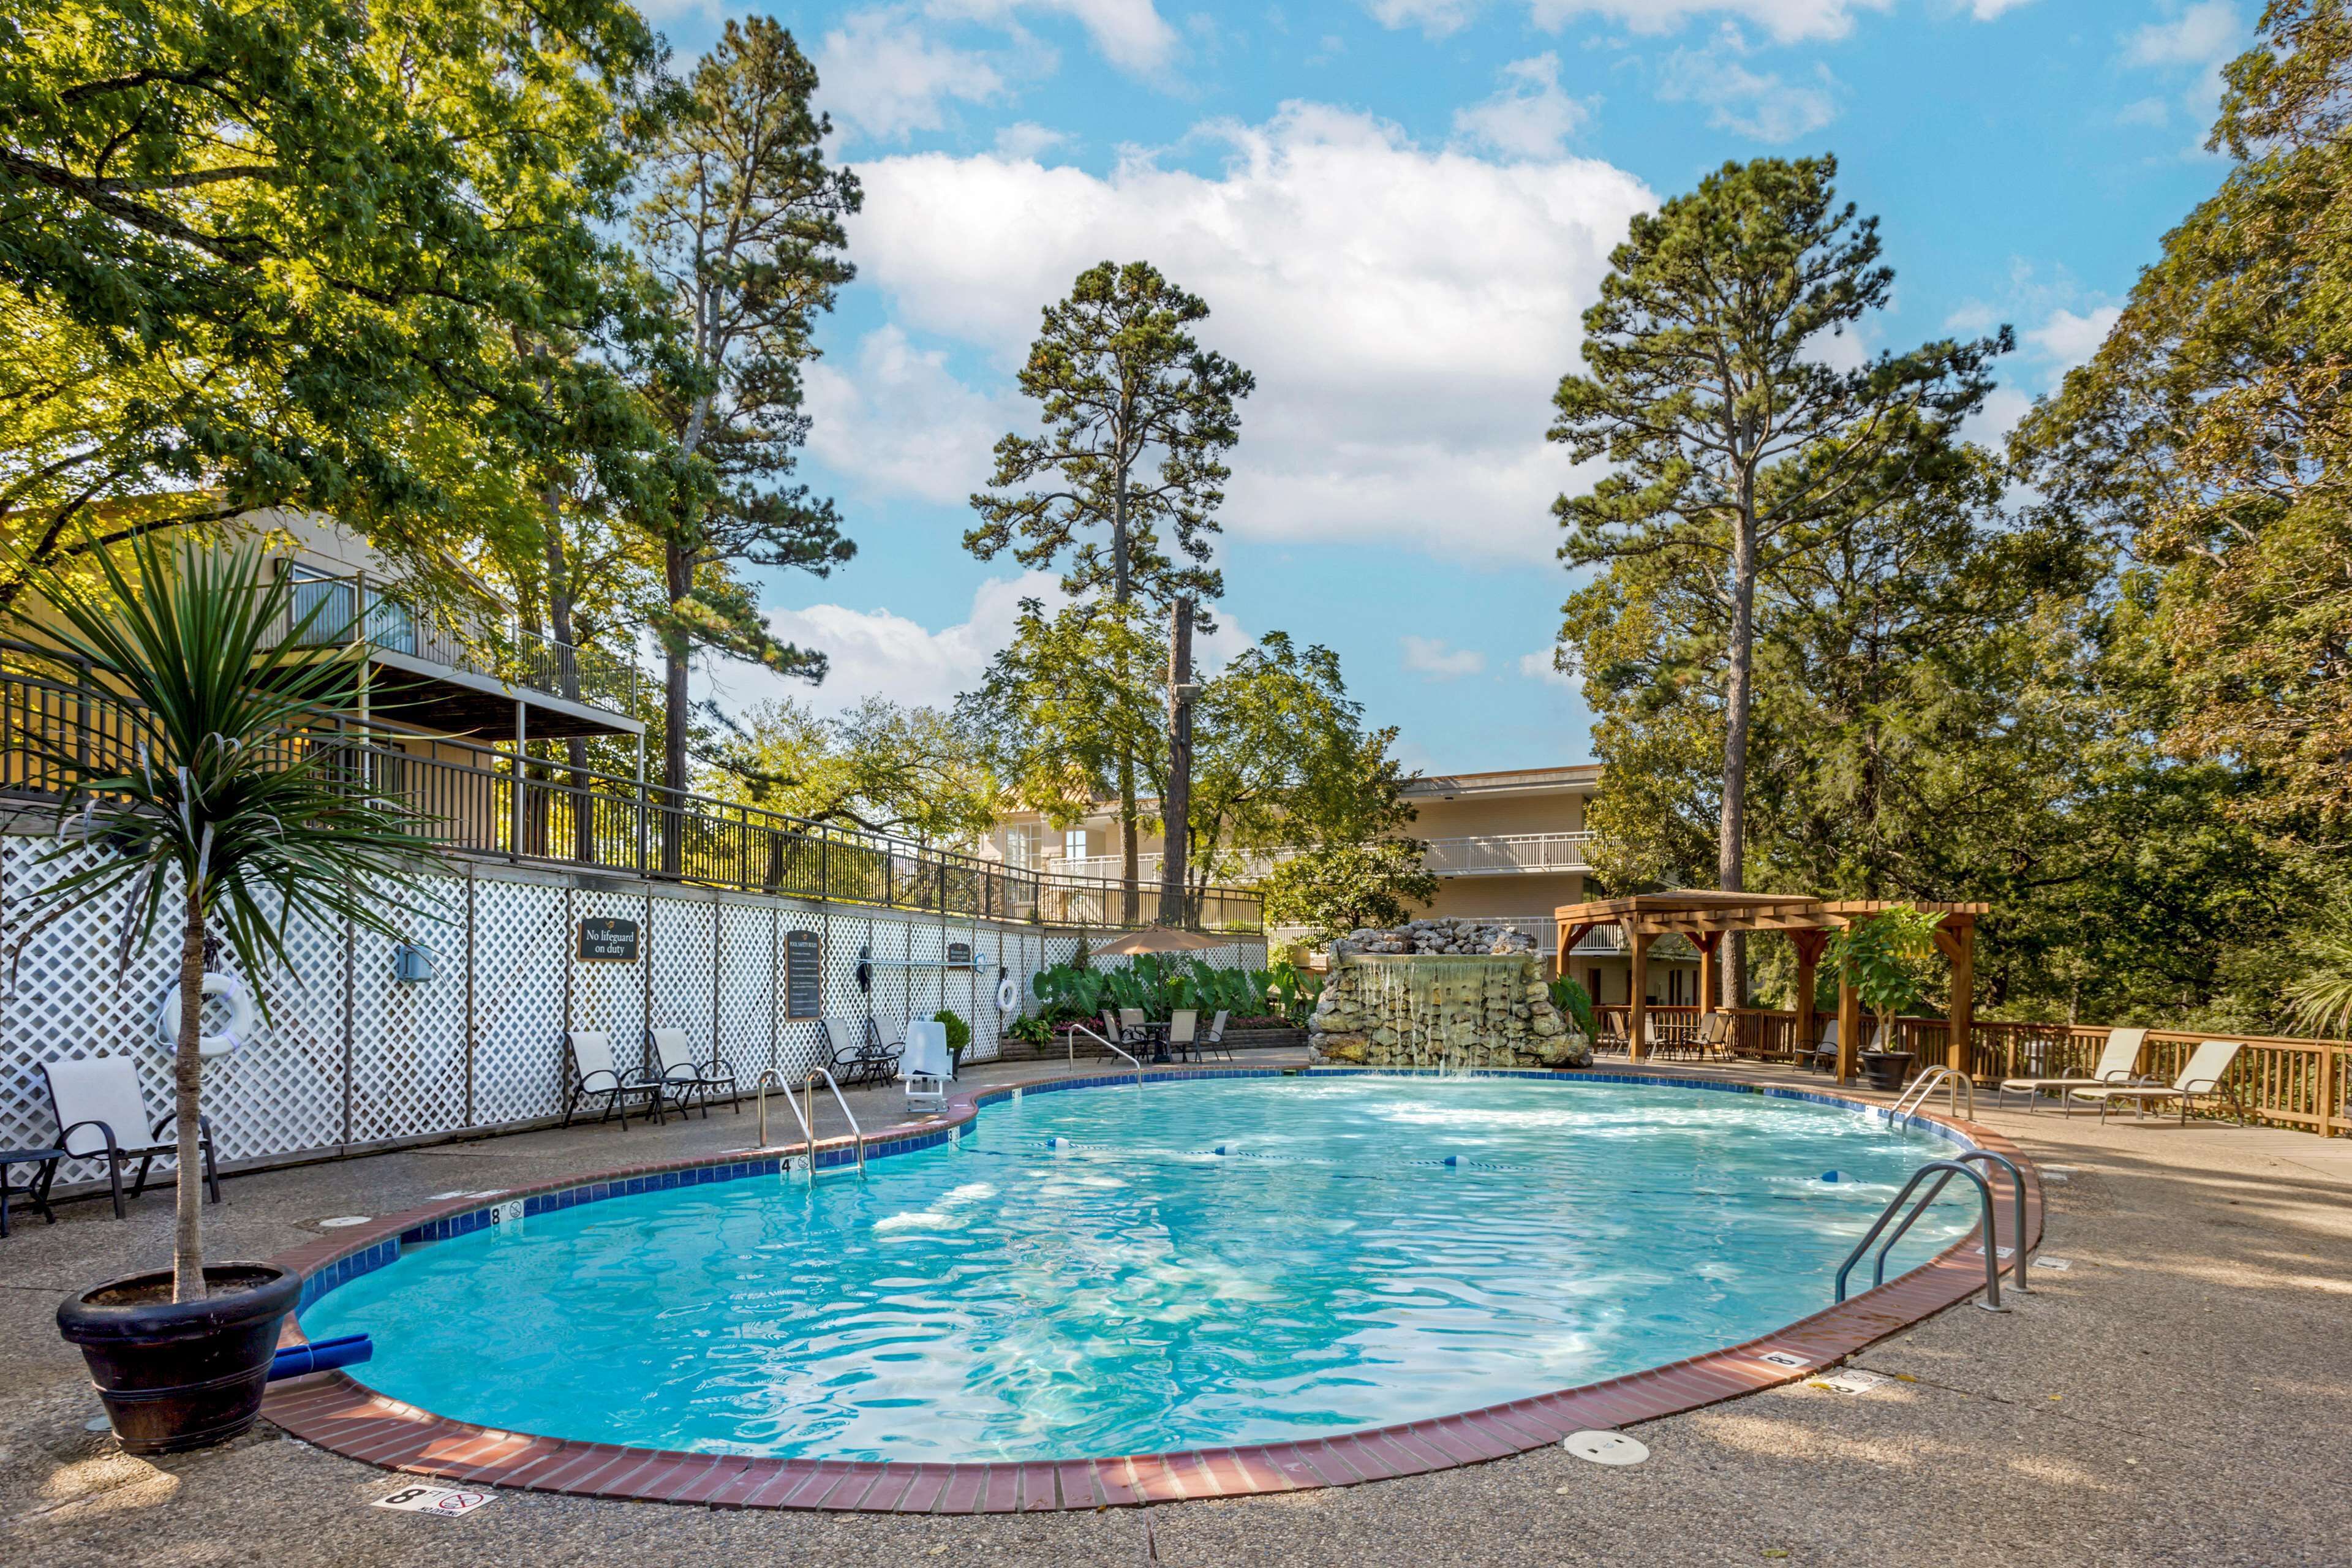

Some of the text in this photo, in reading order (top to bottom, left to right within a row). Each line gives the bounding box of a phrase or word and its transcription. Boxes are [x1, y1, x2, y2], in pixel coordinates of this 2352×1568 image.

[586, 929, 634, 944] No lifeguard
[607, 943, 625, 956] duty
[949, 1130, 952, 1141] 3
[782, 1159, 791, 1172] 4
[492, 1208, 500, 1225] 8
[1767, 1356, 1796, 1365] 8
[385, 1488, 427, 1504] 8
[430, 1507, 461, 1517] DIVING
